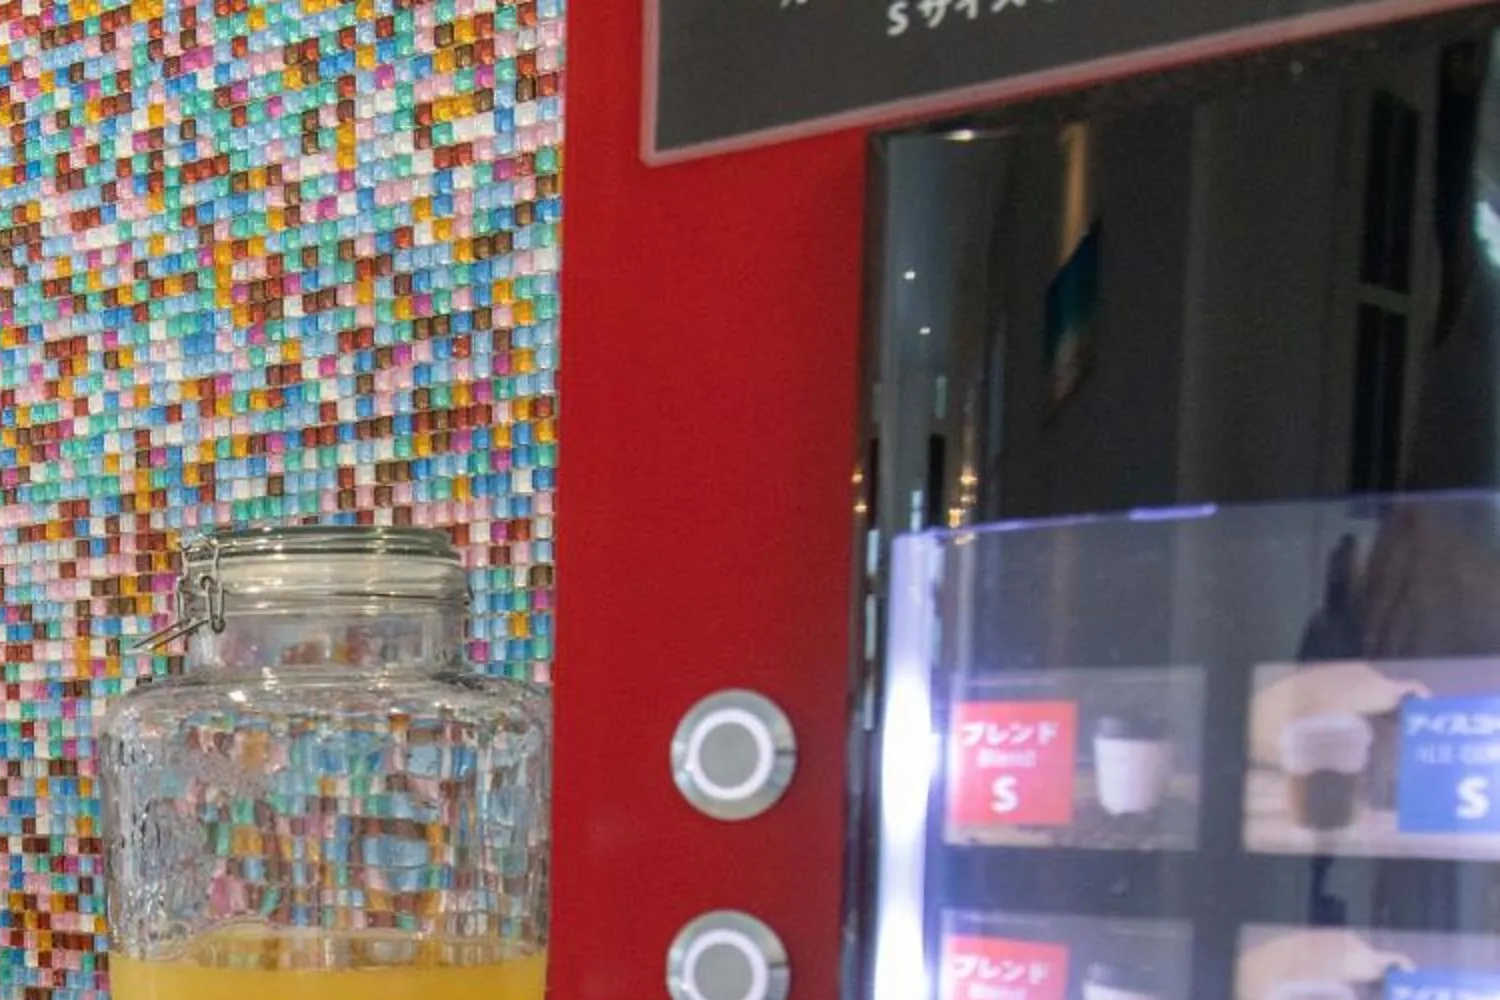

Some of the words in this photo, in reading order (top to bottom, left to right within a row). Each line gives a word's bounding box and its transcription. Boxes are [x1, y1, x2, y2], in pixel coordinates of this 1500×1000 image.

[960, 719, 1059, 746] ブレンド
[991, 774, 1019, 813] S
[1456, 776, 1490, 819] S
